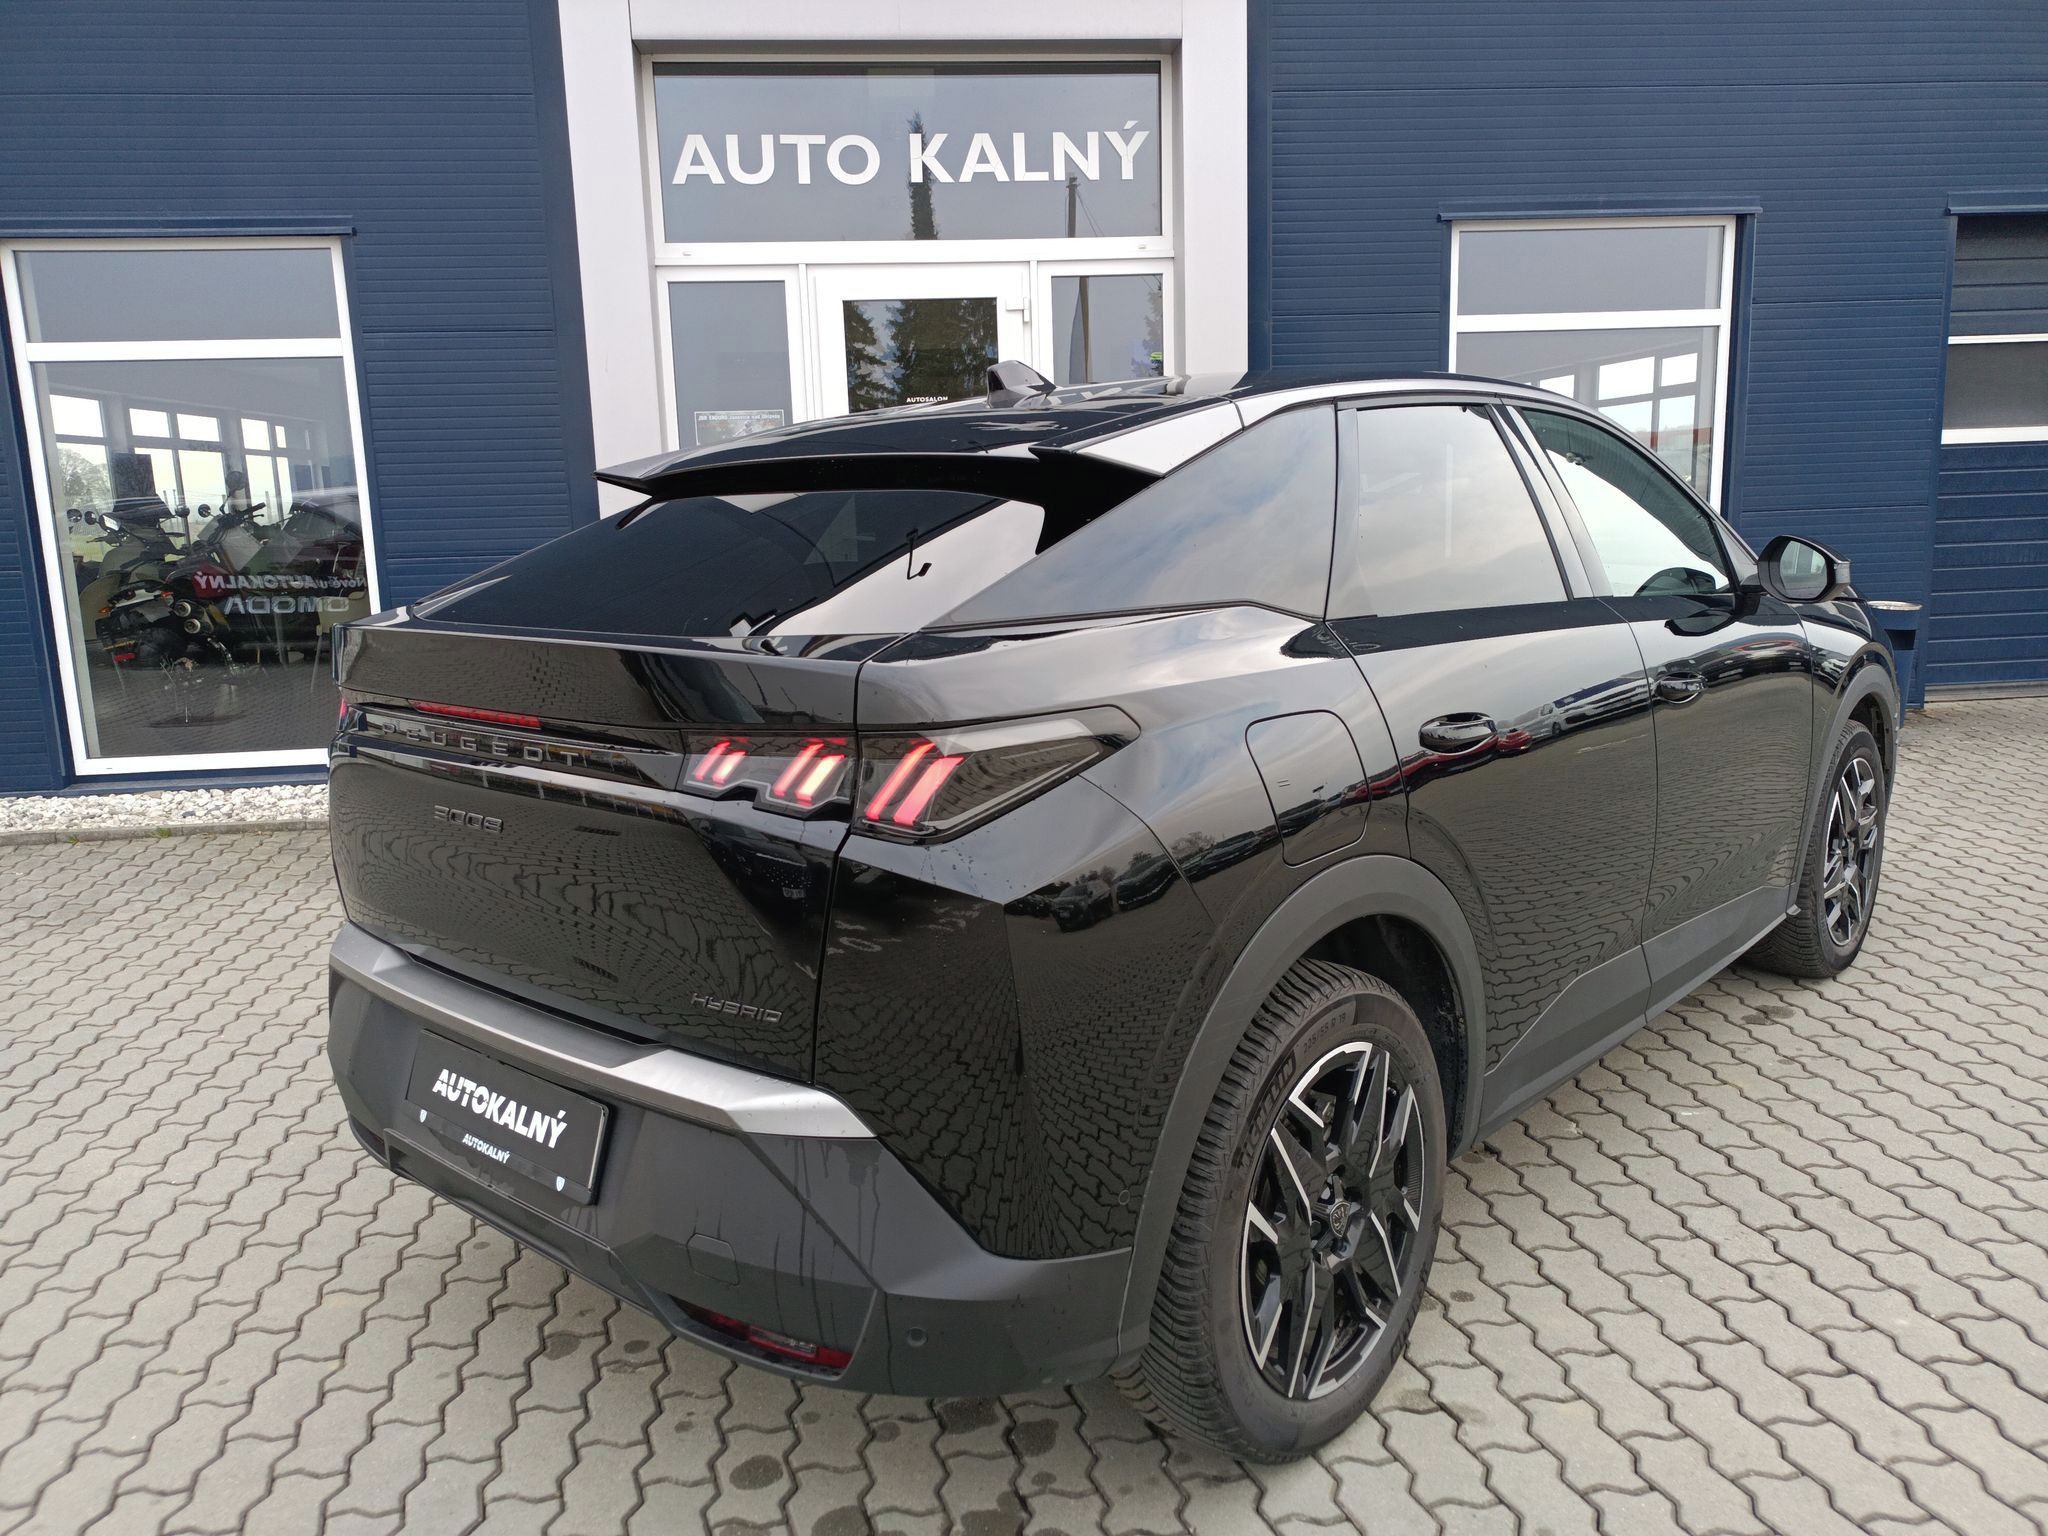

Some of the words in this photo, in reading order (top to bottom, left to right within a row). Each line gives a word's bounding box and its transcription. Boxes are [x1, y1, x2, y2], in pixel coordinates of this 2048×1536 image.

[672, 133, 880, 186] AUTO
[908, 120, 1150, 183] KALNÝ
[906, 395, 949, 404] AUTOSALON
[382, 722, 580, 766] PEUGEOT
[434, 804, 504, 834] 3008
[691, 992, 784, 1024] HYBRID
[431, 1068, 568, 1149] AUTOKALNÝ
[462, 1132, 511, 1164] AUTOKALNÝ
